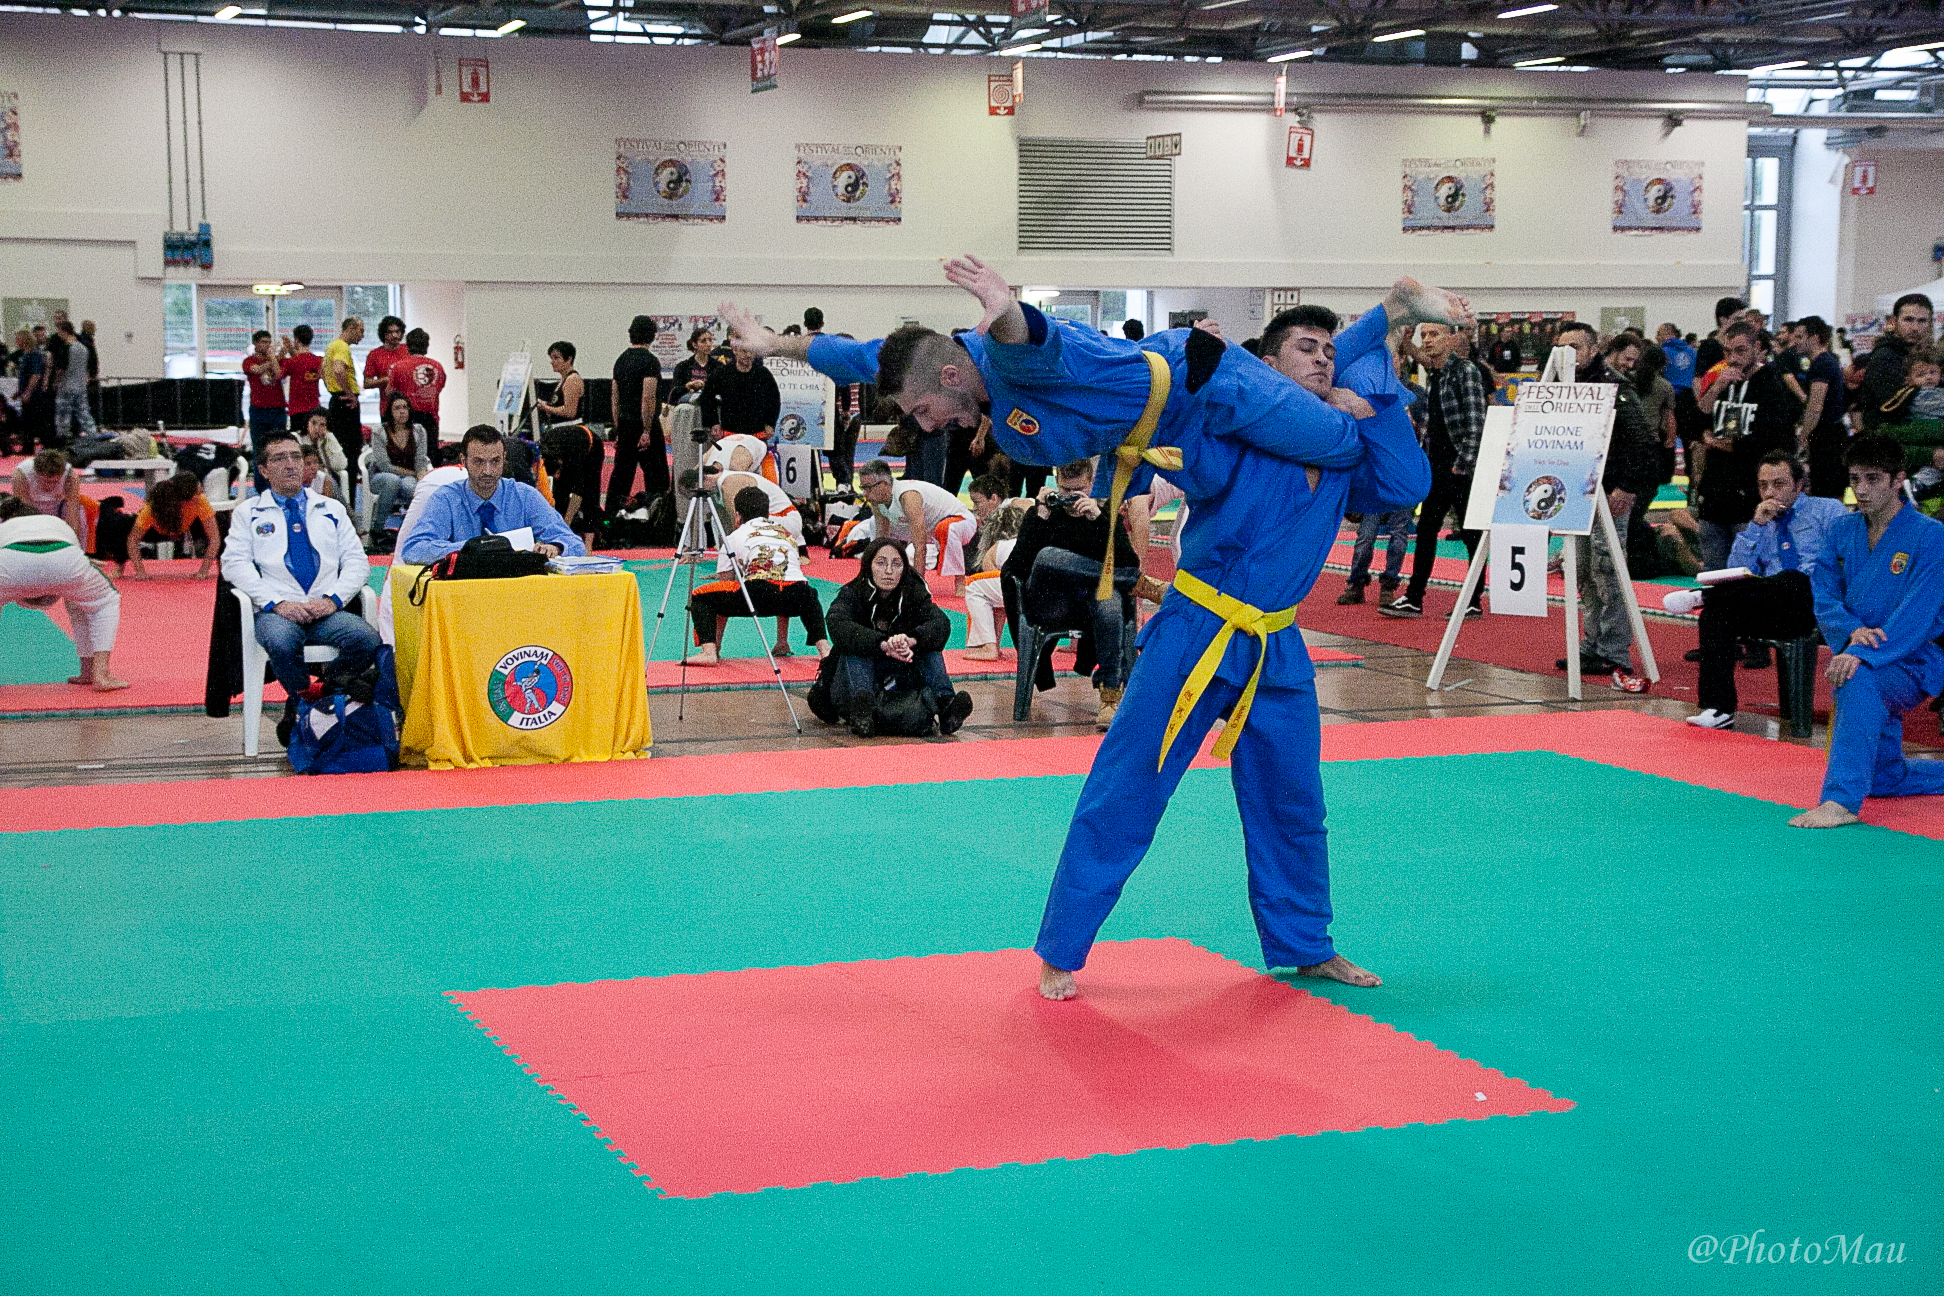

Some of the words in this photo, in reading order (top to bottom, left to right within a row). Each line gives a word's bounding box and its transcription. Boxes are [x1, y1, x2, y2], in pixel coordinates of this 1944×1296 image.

[769, 359, 810, 368] FESTIV
[1526, 385, 1606, 401] FESTIVAL
[1541, 400, 1604, 414] ORIENTE
[1534, 425, 1583, 437] UNIONE
[1527, 439, 1585, 450] VOVINAM
[785, 456, 797, 484] 6
[1509, 545, 1526, 592] 5
[499, 649, 550, 671] VOVINAM
[519, 709, 557, 727] ITALIA
